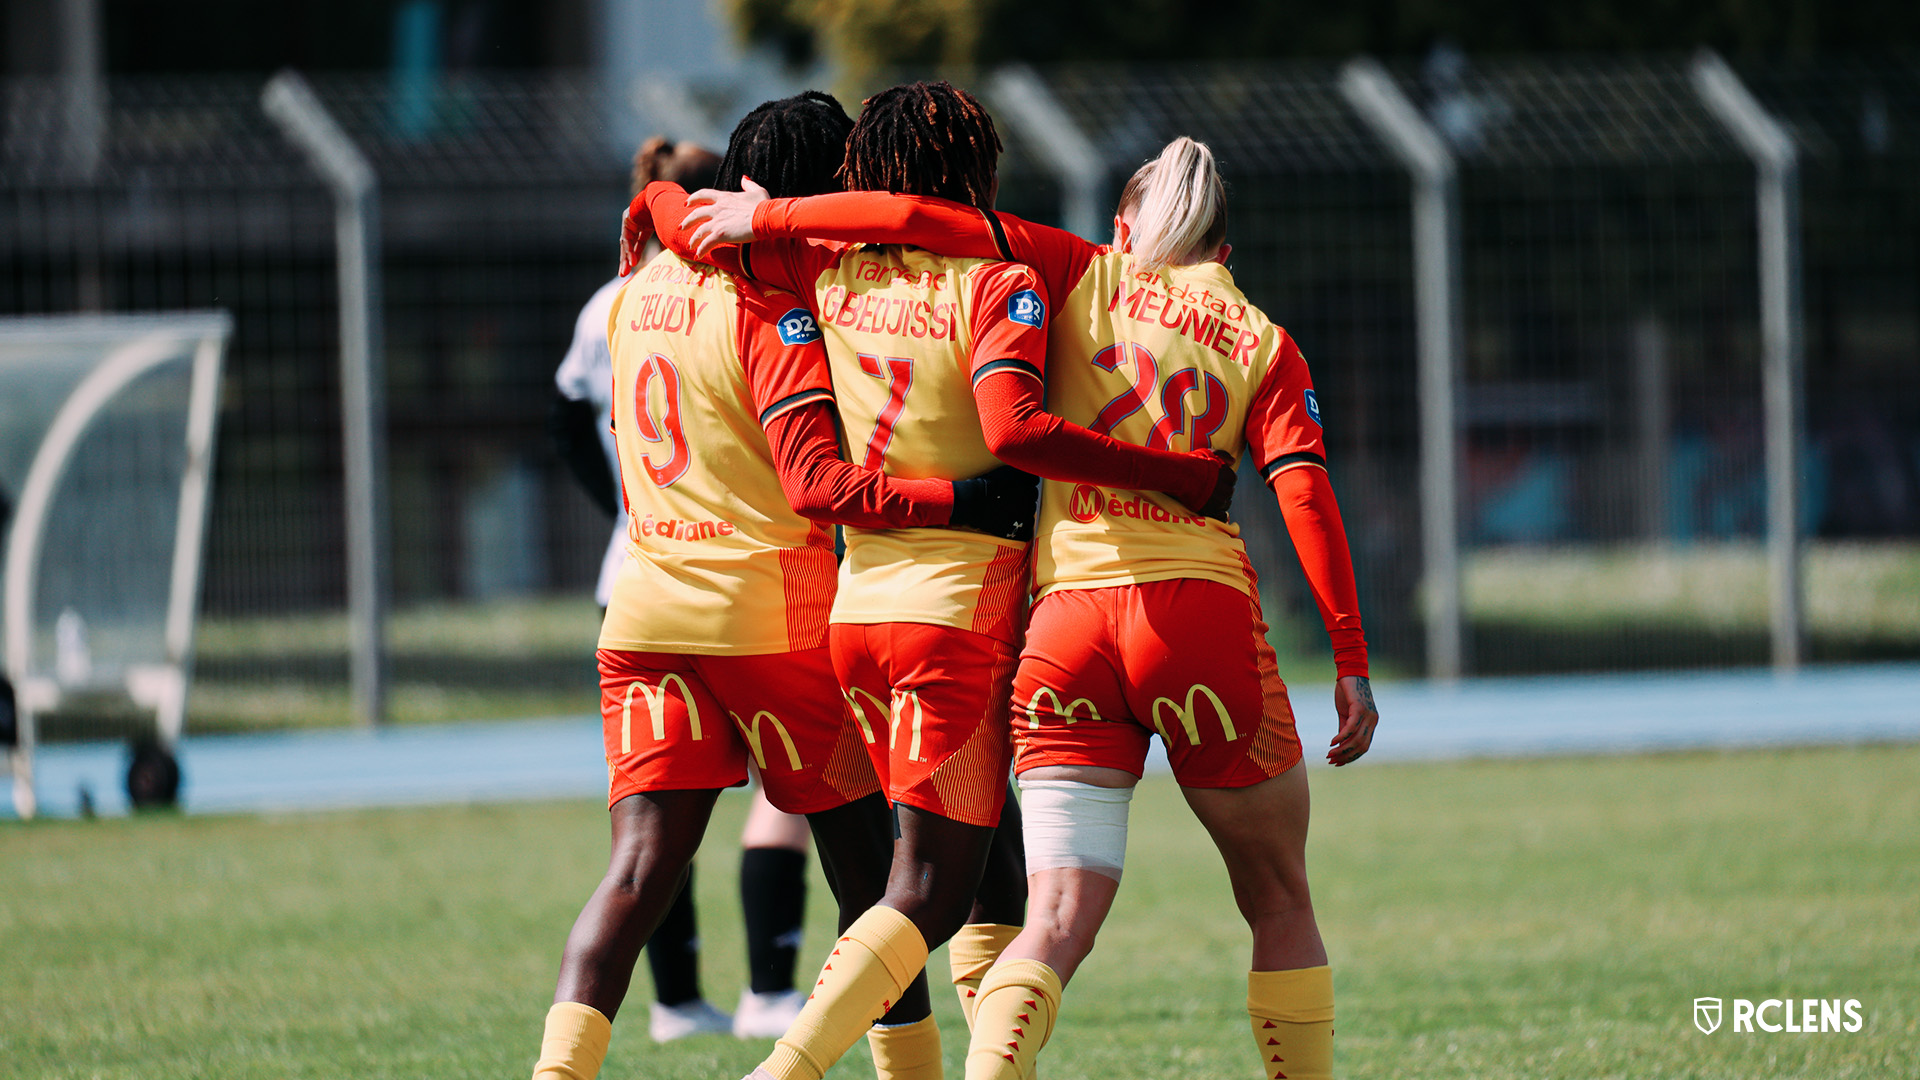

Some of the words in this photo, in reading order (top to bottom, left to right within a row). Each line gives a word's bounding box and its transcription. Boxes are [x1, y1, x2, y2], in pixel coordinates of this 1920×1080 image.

[631, 293, 709, 336] JEUDY
[783, 315, 817, 337] D2
[823, 286, 957, 341] GBEDJISSI
[1108, 281, 1260, 367] MEUNIER
[1127, 262, 1246, 322] andstad
[633, 351, 692, 489] 9
[856, 351, 915, 471] 7
[1087, 341, 1229, 452] 28
